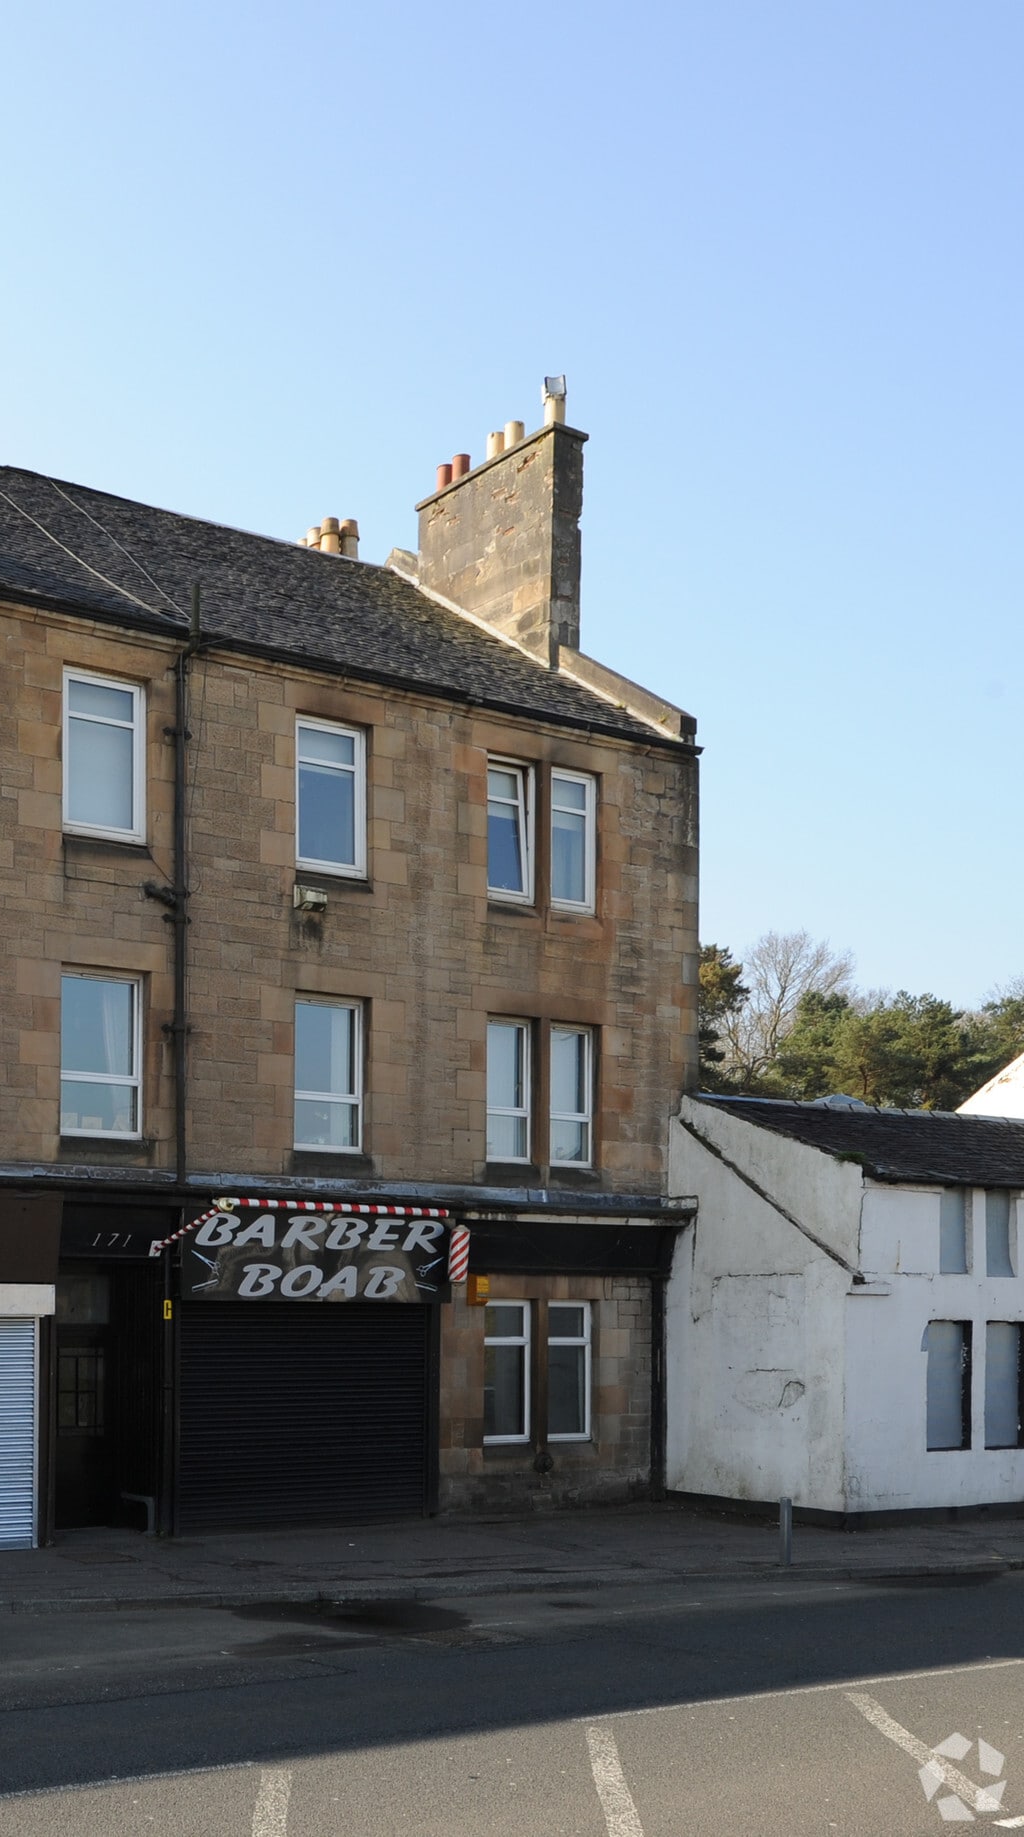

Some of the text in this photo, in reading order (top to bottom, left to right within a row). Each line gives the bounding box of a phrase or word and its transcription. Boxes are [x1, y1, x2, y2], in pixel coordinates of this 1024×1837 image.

[92, 1232, 132, 1248] 171
[195, 1212, 445, 1254] BARBER
[237, 1263, 406, 1299] BOAB
